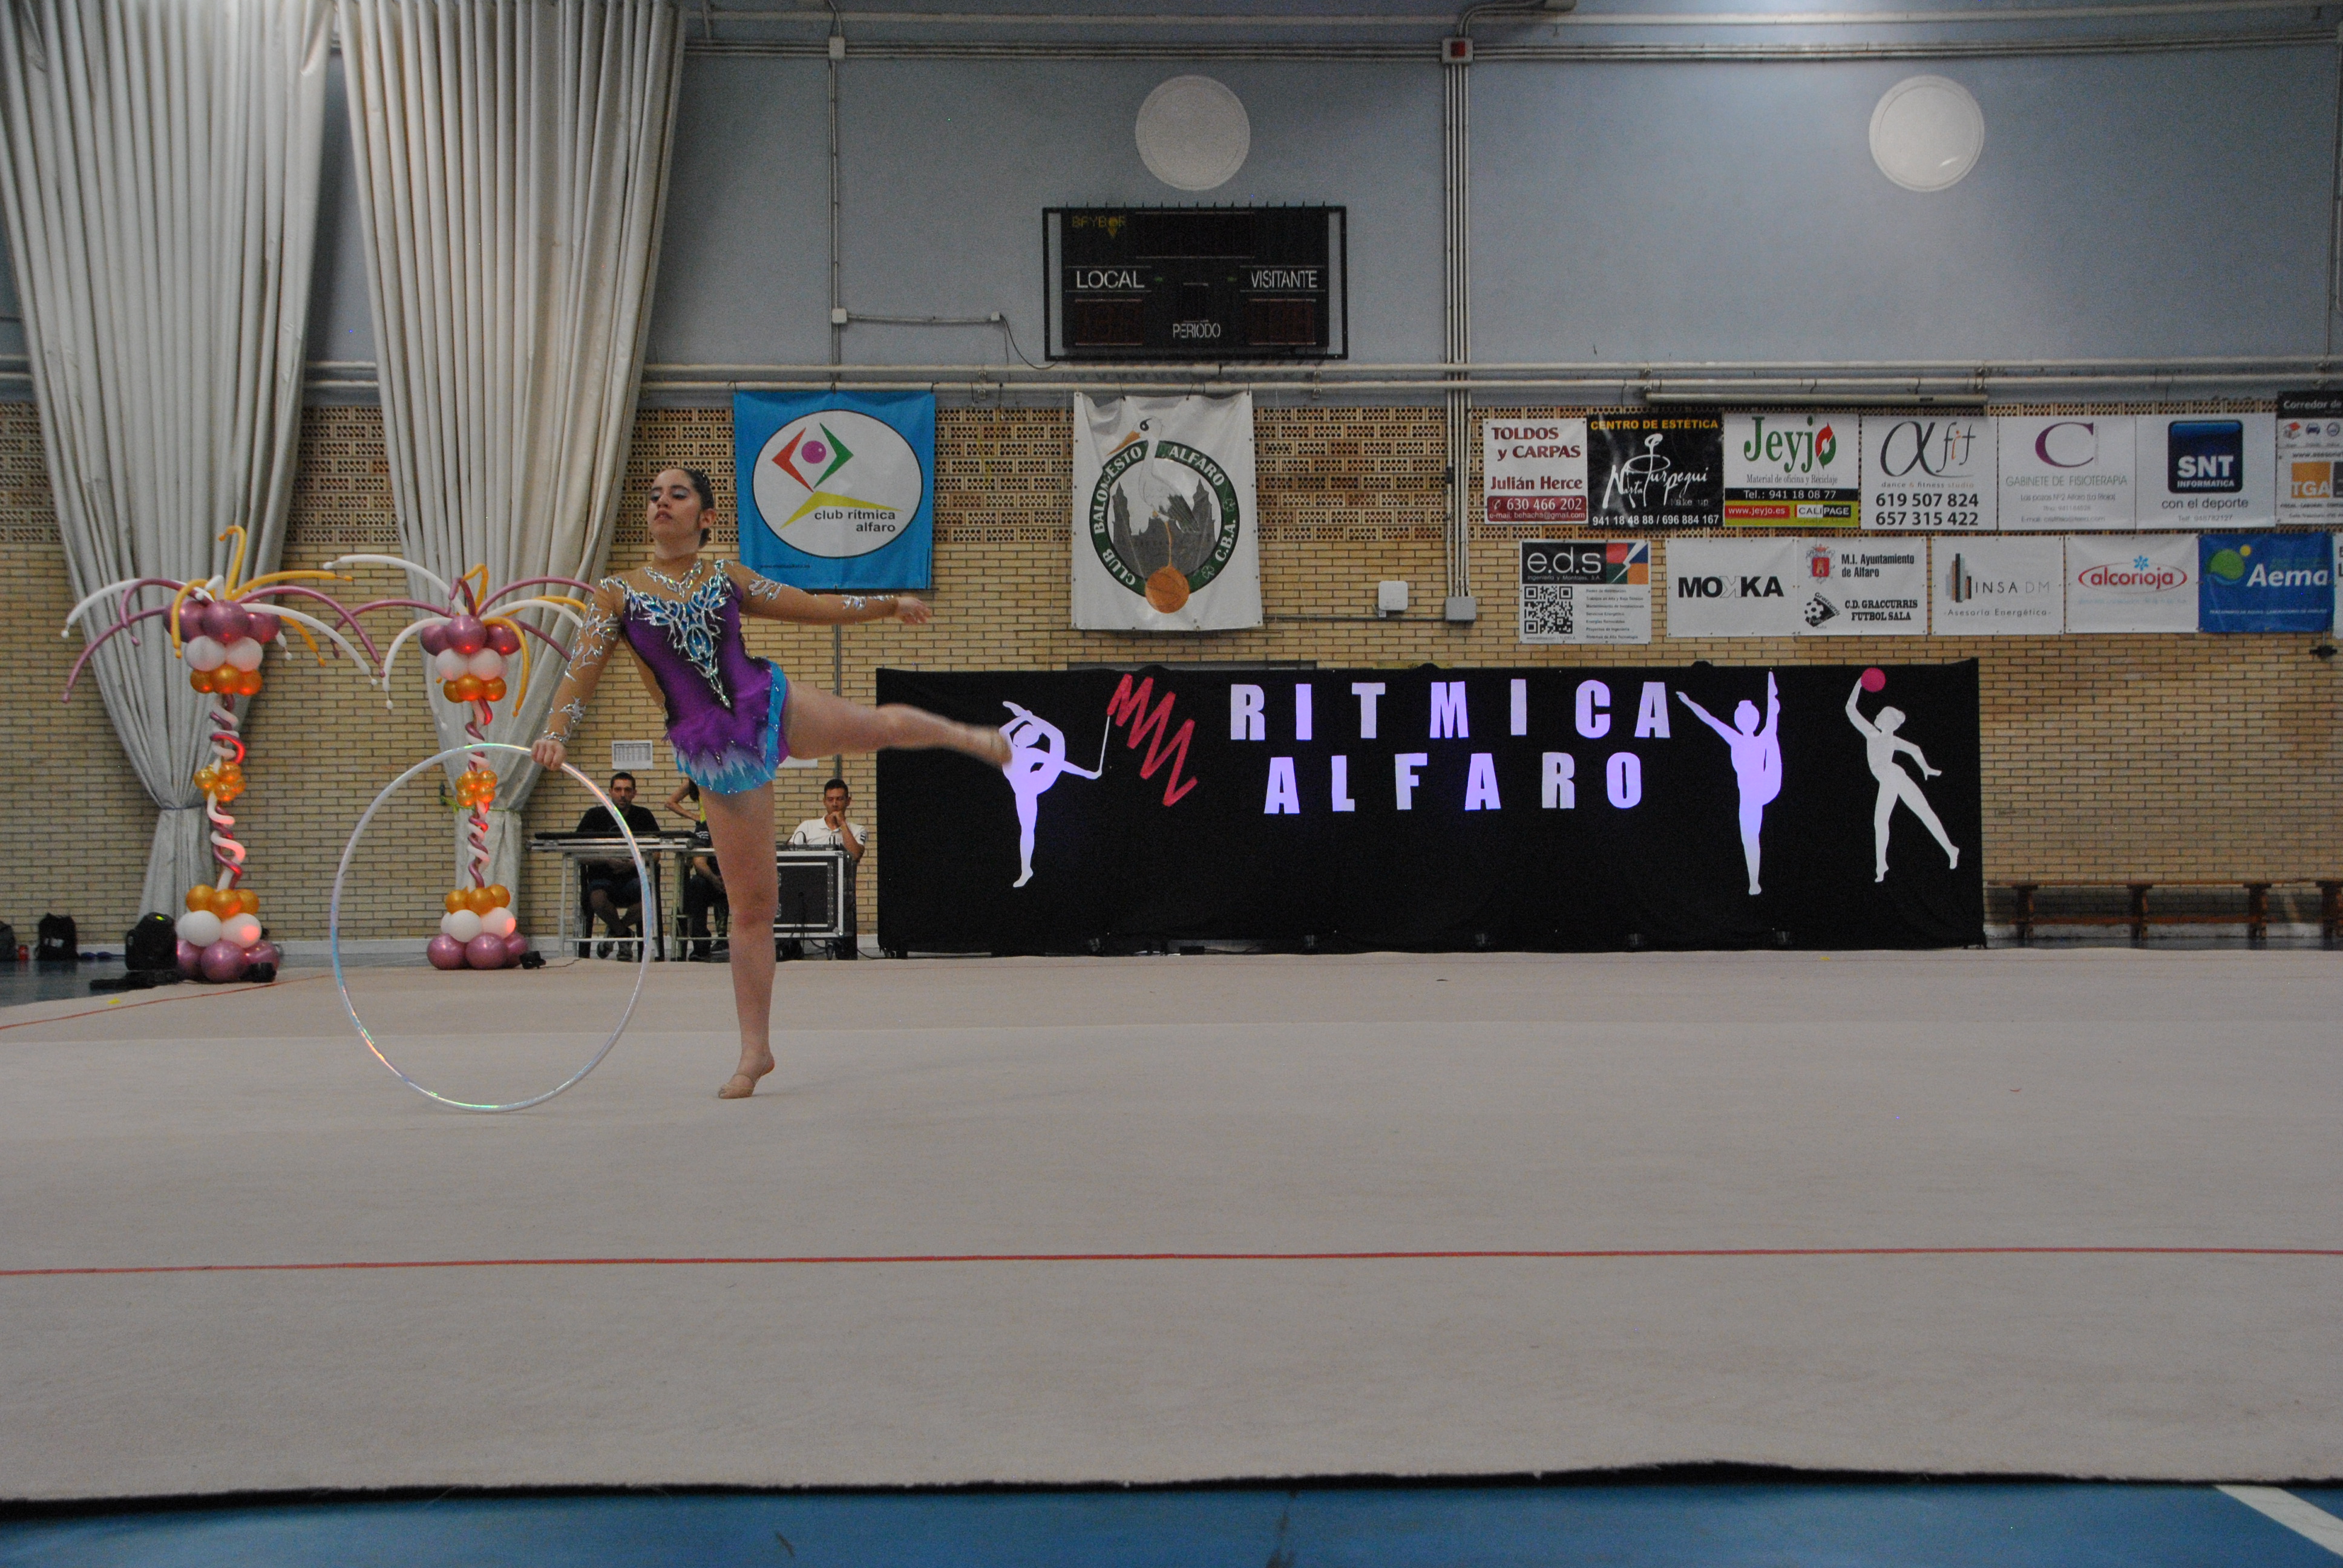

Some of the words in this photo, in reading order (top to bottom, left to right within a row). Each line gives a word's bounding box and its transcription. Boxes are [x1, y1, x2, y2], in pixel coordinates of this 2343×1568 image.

[1076, 270, 1145, 289] LOCAL
[1251, 270, 1318, 289] VISITANTE
[1173, 323, 1221, 339] PERIODO
[2283, 399, 2328, 410] Corredor
[1591, 420, 1639, 430] CENTRO
[1643, 420, 1658, 429] DE
[1662, 417, 1719, 429] ESTÉTICA
[1491, 427, 1559, 440] TOLDOS
[1743, 416, 1837, 473] Jeyjo
[1497, 449, 1507, 462] y
[1513, 445, 1581, 458] CARPAS
[2177, 455, 2233, 478] SNT
[1490, 476, 1535, 489] Julián
[1541, 476, 1583, 489] Herce
[1746, 474, 1774, 483] Material
[1775, 474, 1782, 483] de
[1784, 474, 1804, 483] oficina
[1812, 474, 1838, 485] Reciclaje
[2006, 475, 2049, 486] GABINETE
[2052, 475, 2064, 486] DE
[2069, 475, 2127, 486] FISIOTERAPIA
[1743, 490, 1765, 499] Tel.:
[1769, 490, 1788, 499] 941
[1793, 490, 1804, 499] 18
[1808, 490, 1820, 499] 08
[1824, 490, 1837, 498] 77
[2293, 481, 2330, 495] TGA
[1507, 498, 1529, 510] 630
[1533, 498, 1556, 510] 466
[1560, 498, 1582, 510] 202
[1876, 493, 1907, 507] 619
[1912, 493, 1942, 507] 507
[1947, 493, 1978, 507] 824
[2161, 500, 2183, 509] con
[2187, 498, 2198, 509] el
[2201, 498, 2249, 511] deporte
[814, 510, 844, 520] club
[847, 509, 896, 520] rítmica
[1103, 548, 1135, 586] CLUB
[1168, 446, 1225, 486] ALFARO
[1728, 506, 1785, 516] www.jeyjo.es
[1593, 516, 1609, 525] 941
[1613, 516, 1624, 525] 18
[1628, 515, 1639, 525] 48
[1642, 515, 1654, 524] 88
[1662, 515, 1680, 524] 696
[1682, 515, 1699, 524] 884
[1702, 515, 1719, 524] 167
[1876, 512, 1907, 526] 657
[1912, 512, 1942, 526] 315
[1947, 512, 1978, 526] 422
[856, 522, 896, 532] alfaro
[1527, 546, 1601, 573] e.d.s
[1841, 554, 1858, 564] M.I.
[1860, 554, 1915, 566] Ayuntamiento
[1841, 567, 1851, 577] de
[1854, 567, 1879, 577] Alfaro
[2091, 566, 2174, 590] alcorioja
[2246, 563, 2329, 587] Aema
[1845, 600, 1860, 609] C.D.
[1861, 599, 1918, 609] GRACCURRIS
[1852, 612, 1886, 621] FUTBOL
[1888, 612, 1912, 621] SALA
[1230, 678, 1671, 741] RITMICA
[1264, 752, 1642, 815] ALFARO
